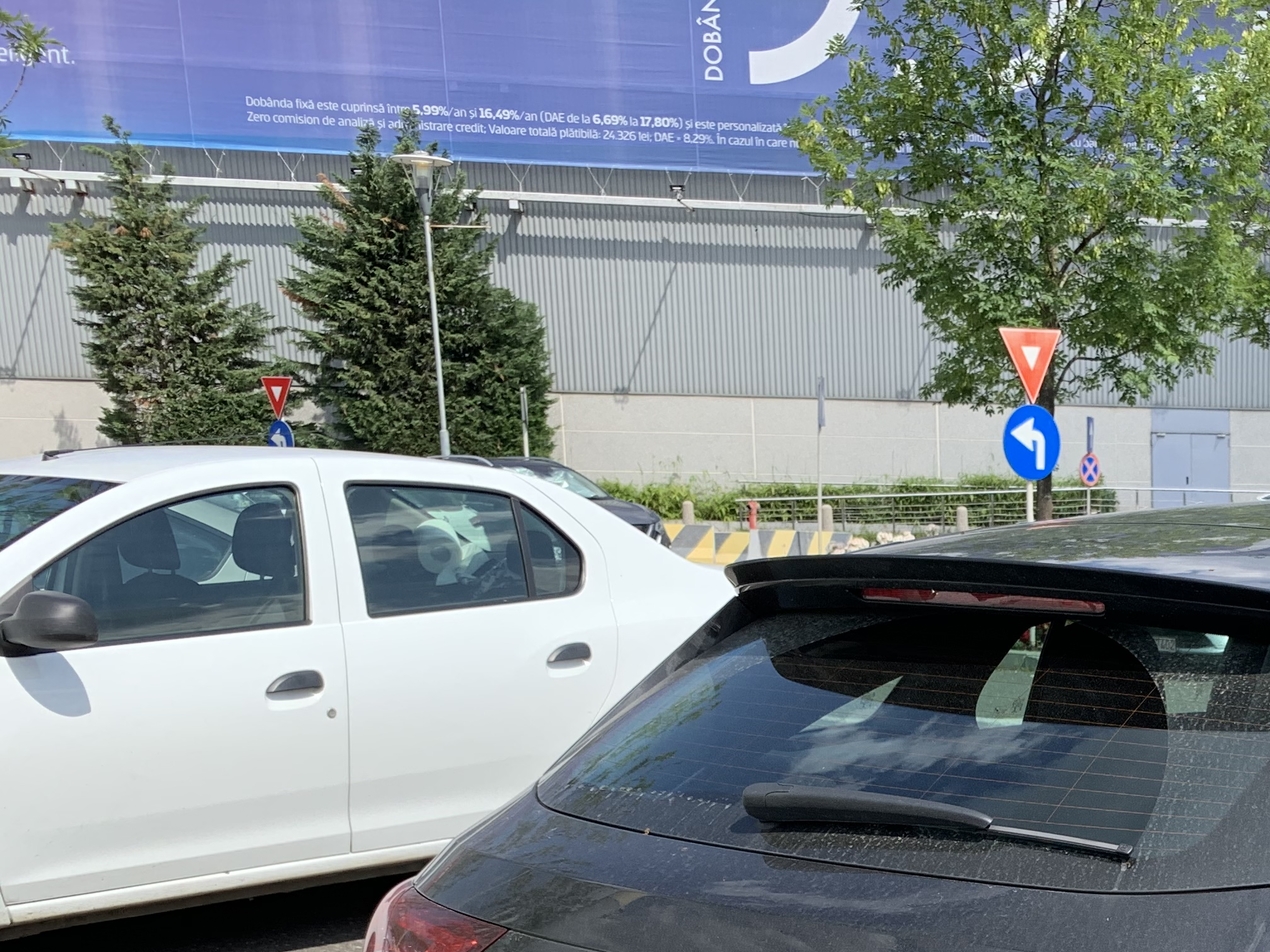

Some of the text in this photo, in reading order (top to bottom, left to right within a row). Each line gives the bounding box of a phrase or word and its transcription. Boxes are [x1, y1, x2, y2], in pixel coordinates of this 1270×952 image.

[245, 96, 294, 110] Dobânda
[295, 98, 315, 111] fixă
[316, 102, 339, 112] este
[340, 103, 385, 115] cuprinsă
[469, 109, 478, 121] și
[479, 108, 538, 123] 16,49%/an
[540, 111, 566, 125] (DAE
[566, 113, 580, 125] de
[581, 114, 591, 125] la
[592, 113, 628, 127] 6,69%
[629, 116, 639, 127] la
[639, 116, 684, 131] 17,80%)
[685, 119, 694, 132] și
[695, 121, 716, 131] este
[717, 122, 782, 136] personalizată
[247, 111, 271, 123] Zero
[272, 114, 321, 126] comision
[322, 116, 336, 127] de
[337, 117, 375, 129] analiză
[376, 119, 386, 131] și
[455, 121, 487, 135] credit;
[488, 124, 527, 137] Valoare
[528, 124, 557, 138] totală
[602, 129, 637, 142] 24.326
[654, 132, 675, 144] DAE
[716, 131, 727, 146] În
[728, 133, 754, 147] cazul
[755, 136, 765, 147] în
[766, 138, 789, 148] care
